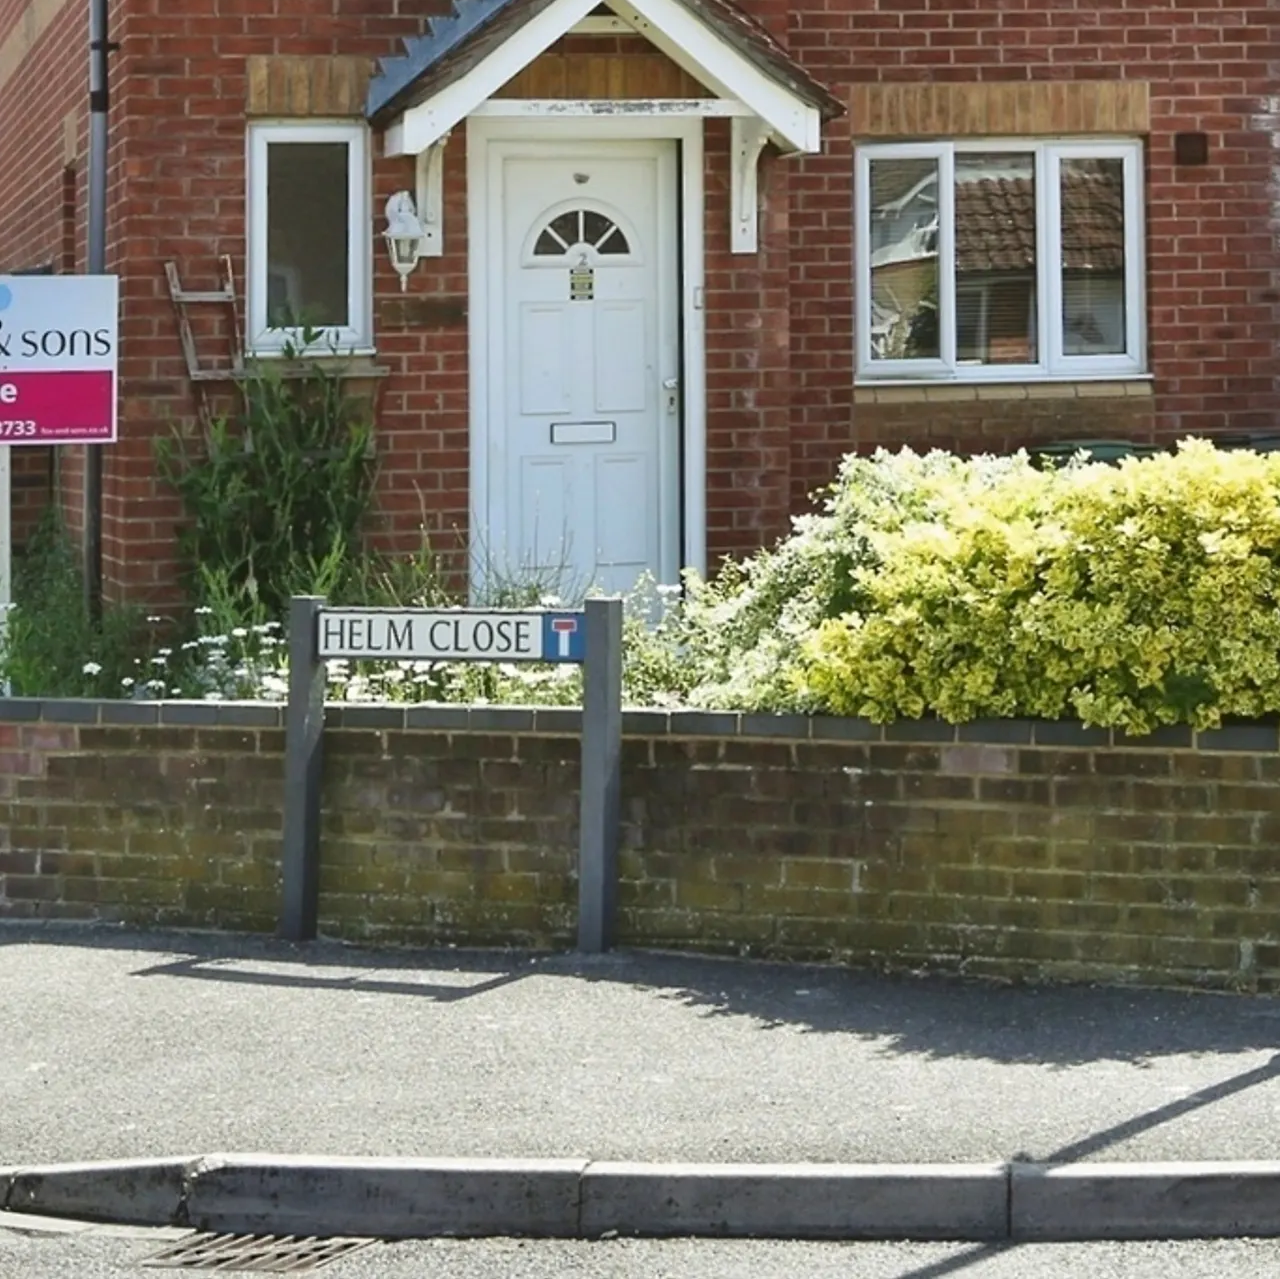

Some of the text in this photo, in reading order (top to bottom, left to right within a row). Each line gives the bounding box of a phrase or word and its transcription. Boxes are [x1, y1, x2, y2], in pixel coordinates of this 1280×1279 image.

[578, 252, 588, 266] 2
[20, 328, 112, 357] sons
[323, 618, 531, 653] HELM CLOSE
